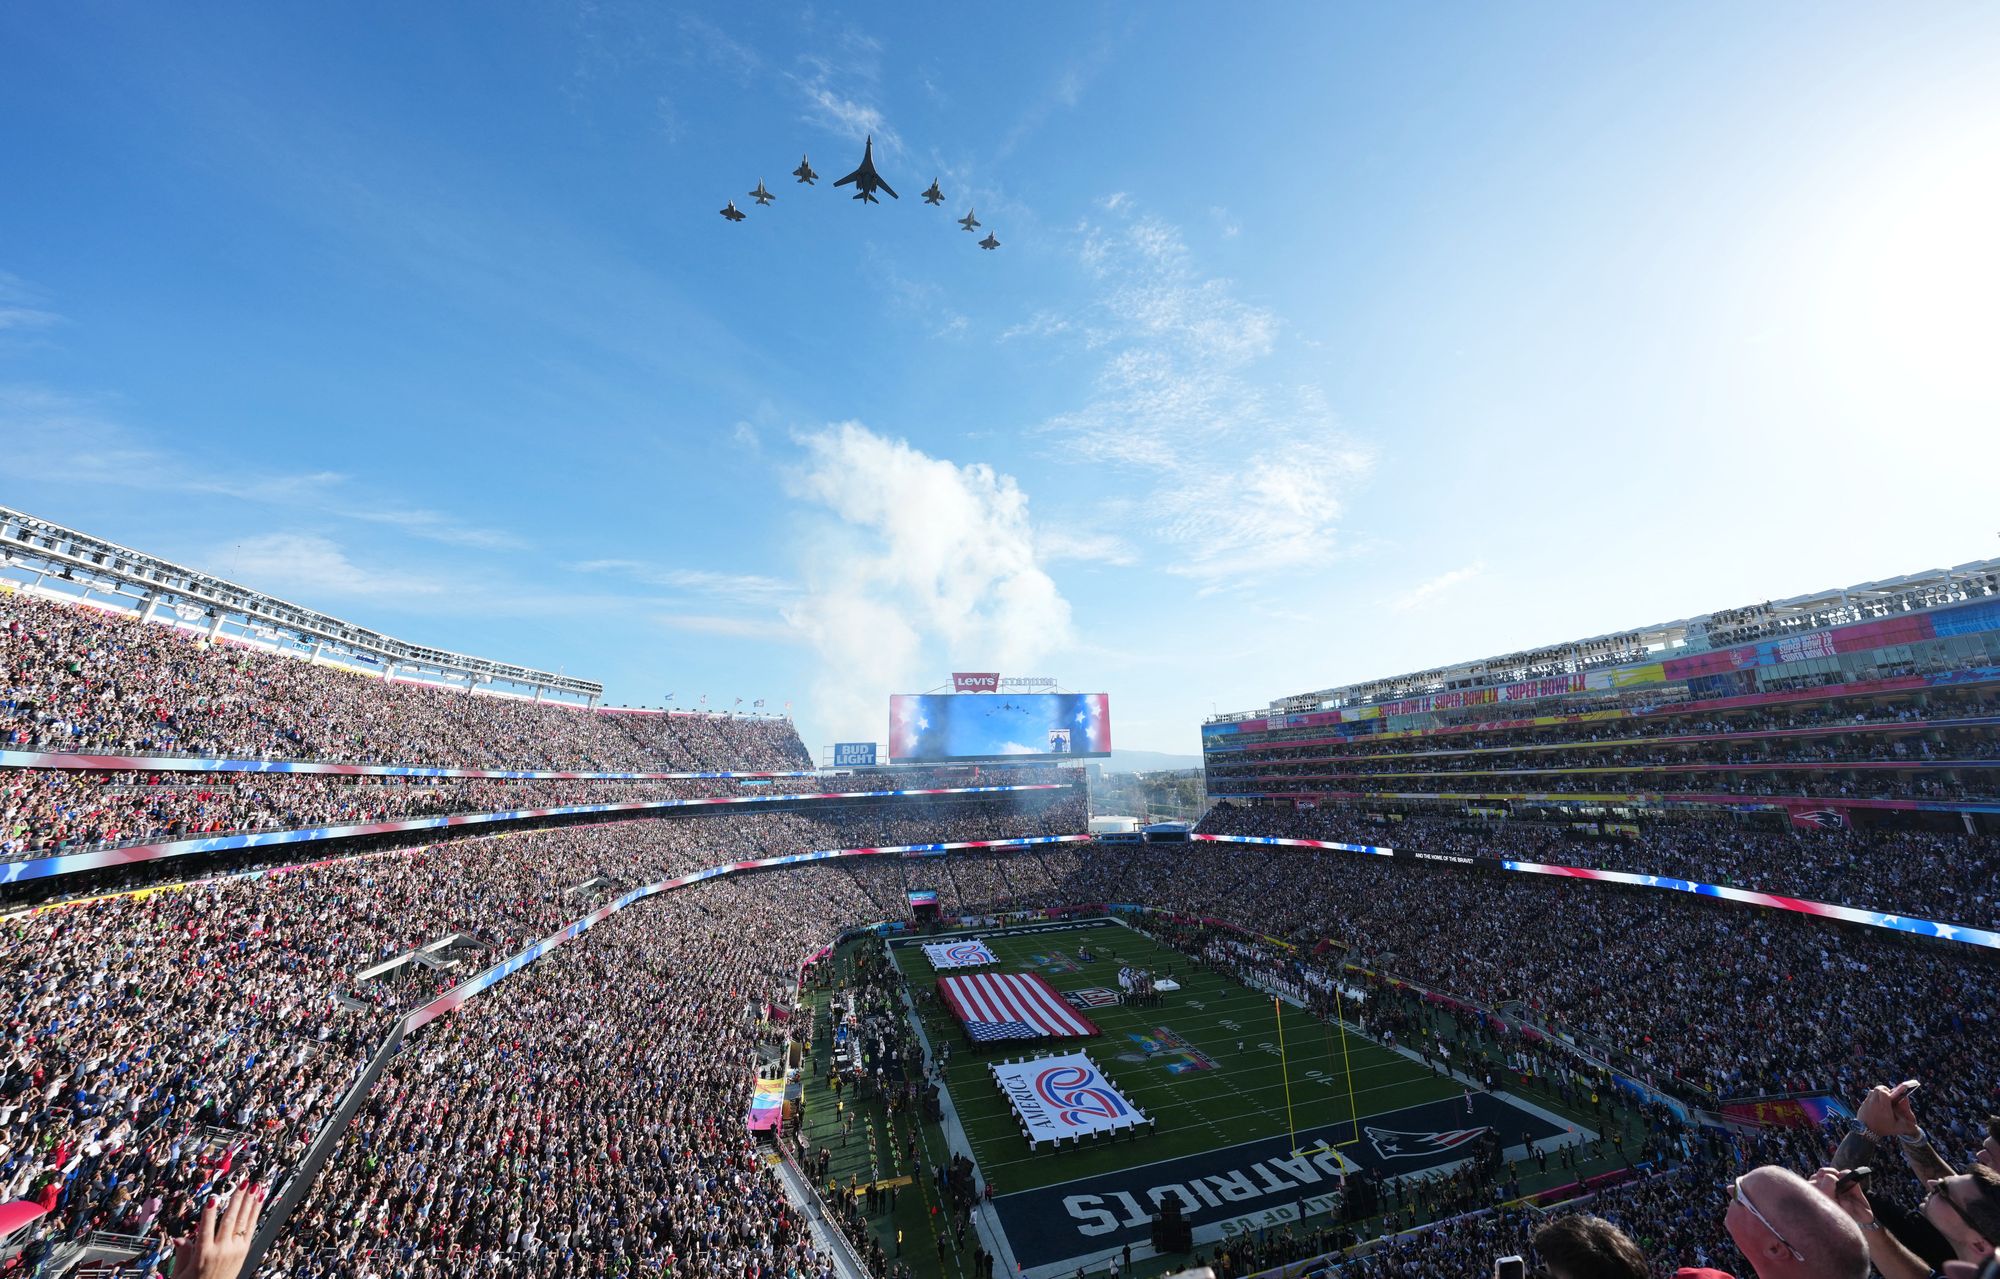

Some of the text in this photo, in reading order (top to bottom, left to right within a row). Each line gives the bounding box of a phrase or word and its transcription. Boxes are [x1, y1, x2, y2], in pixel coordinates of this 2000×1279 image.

[1506, 674, 1586, 700] SUPER BOWL LX
[1379, 697, 1430, 717] SUPER BOWL LX
[1435, 687, 1498, 709] SUPER BOWL LX
[842, 744, 869, 754] BUD
[837, 754, 874, 764] LIGHT
[973, 921, 1107, 939] SEAHAWKS
[1005, 1075, 1056, 1129] AMERICA
[1062, 1138, 1363, 1237] PATRIOTS
[1263, 1207, 1293, 1224] OF
[1220, 1217, 1256, 1235] US
